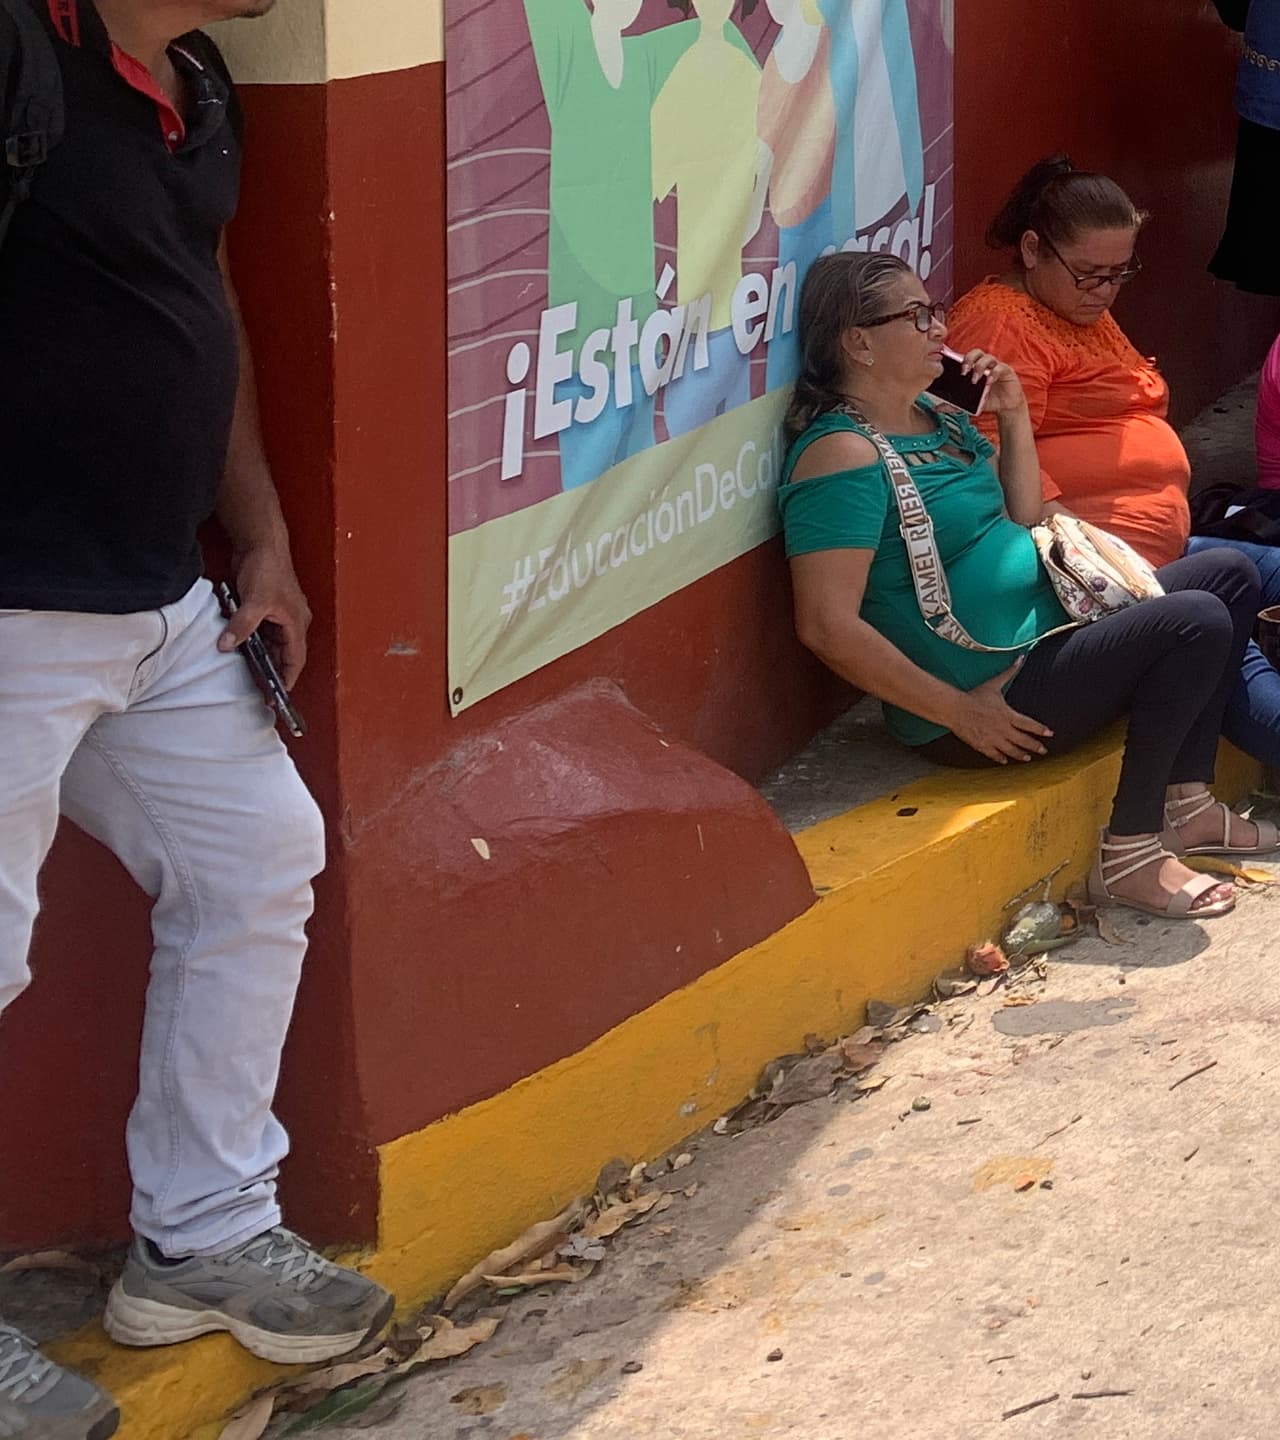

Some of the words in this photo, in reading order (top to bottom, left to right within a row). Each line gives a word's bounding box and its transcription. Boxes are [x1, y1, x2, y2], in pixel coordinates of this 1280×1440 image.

[501, 262, 712, 481] ¡Están
[731, 259, 798, 356] en
[500, 425, 782, 628] #EducaciónDeCal
[915, 545, 942, 619] KAMEL
